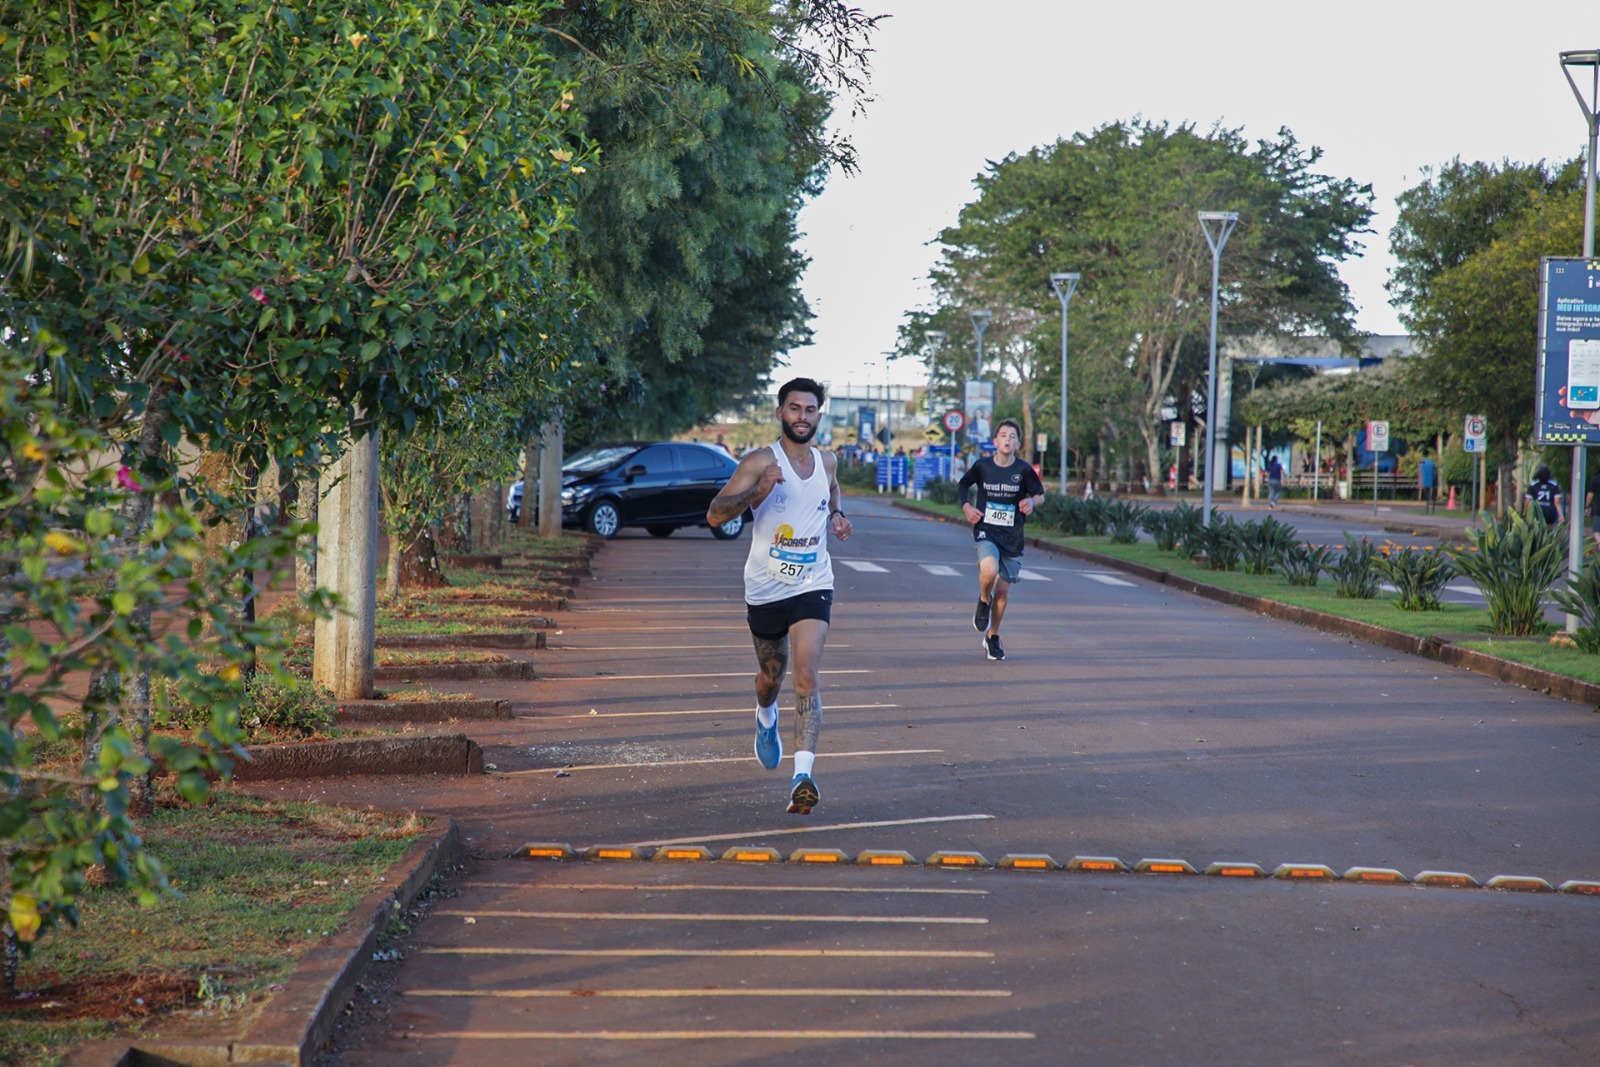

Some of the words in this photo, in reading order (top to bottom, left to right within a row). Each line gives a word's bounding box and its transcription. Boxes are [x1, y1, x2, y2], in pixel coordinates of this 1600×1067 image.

[949, 415, 960, 423] 20
[1376, 426, 1383, 435] E
[1472, 422, 1480, 433] E
[1538, 490, 1550, 500] 21
[992, 511, 1008, 521] 402
[781, 537, 808, 547] CORRE
[780, 562, 804, 577] 257
